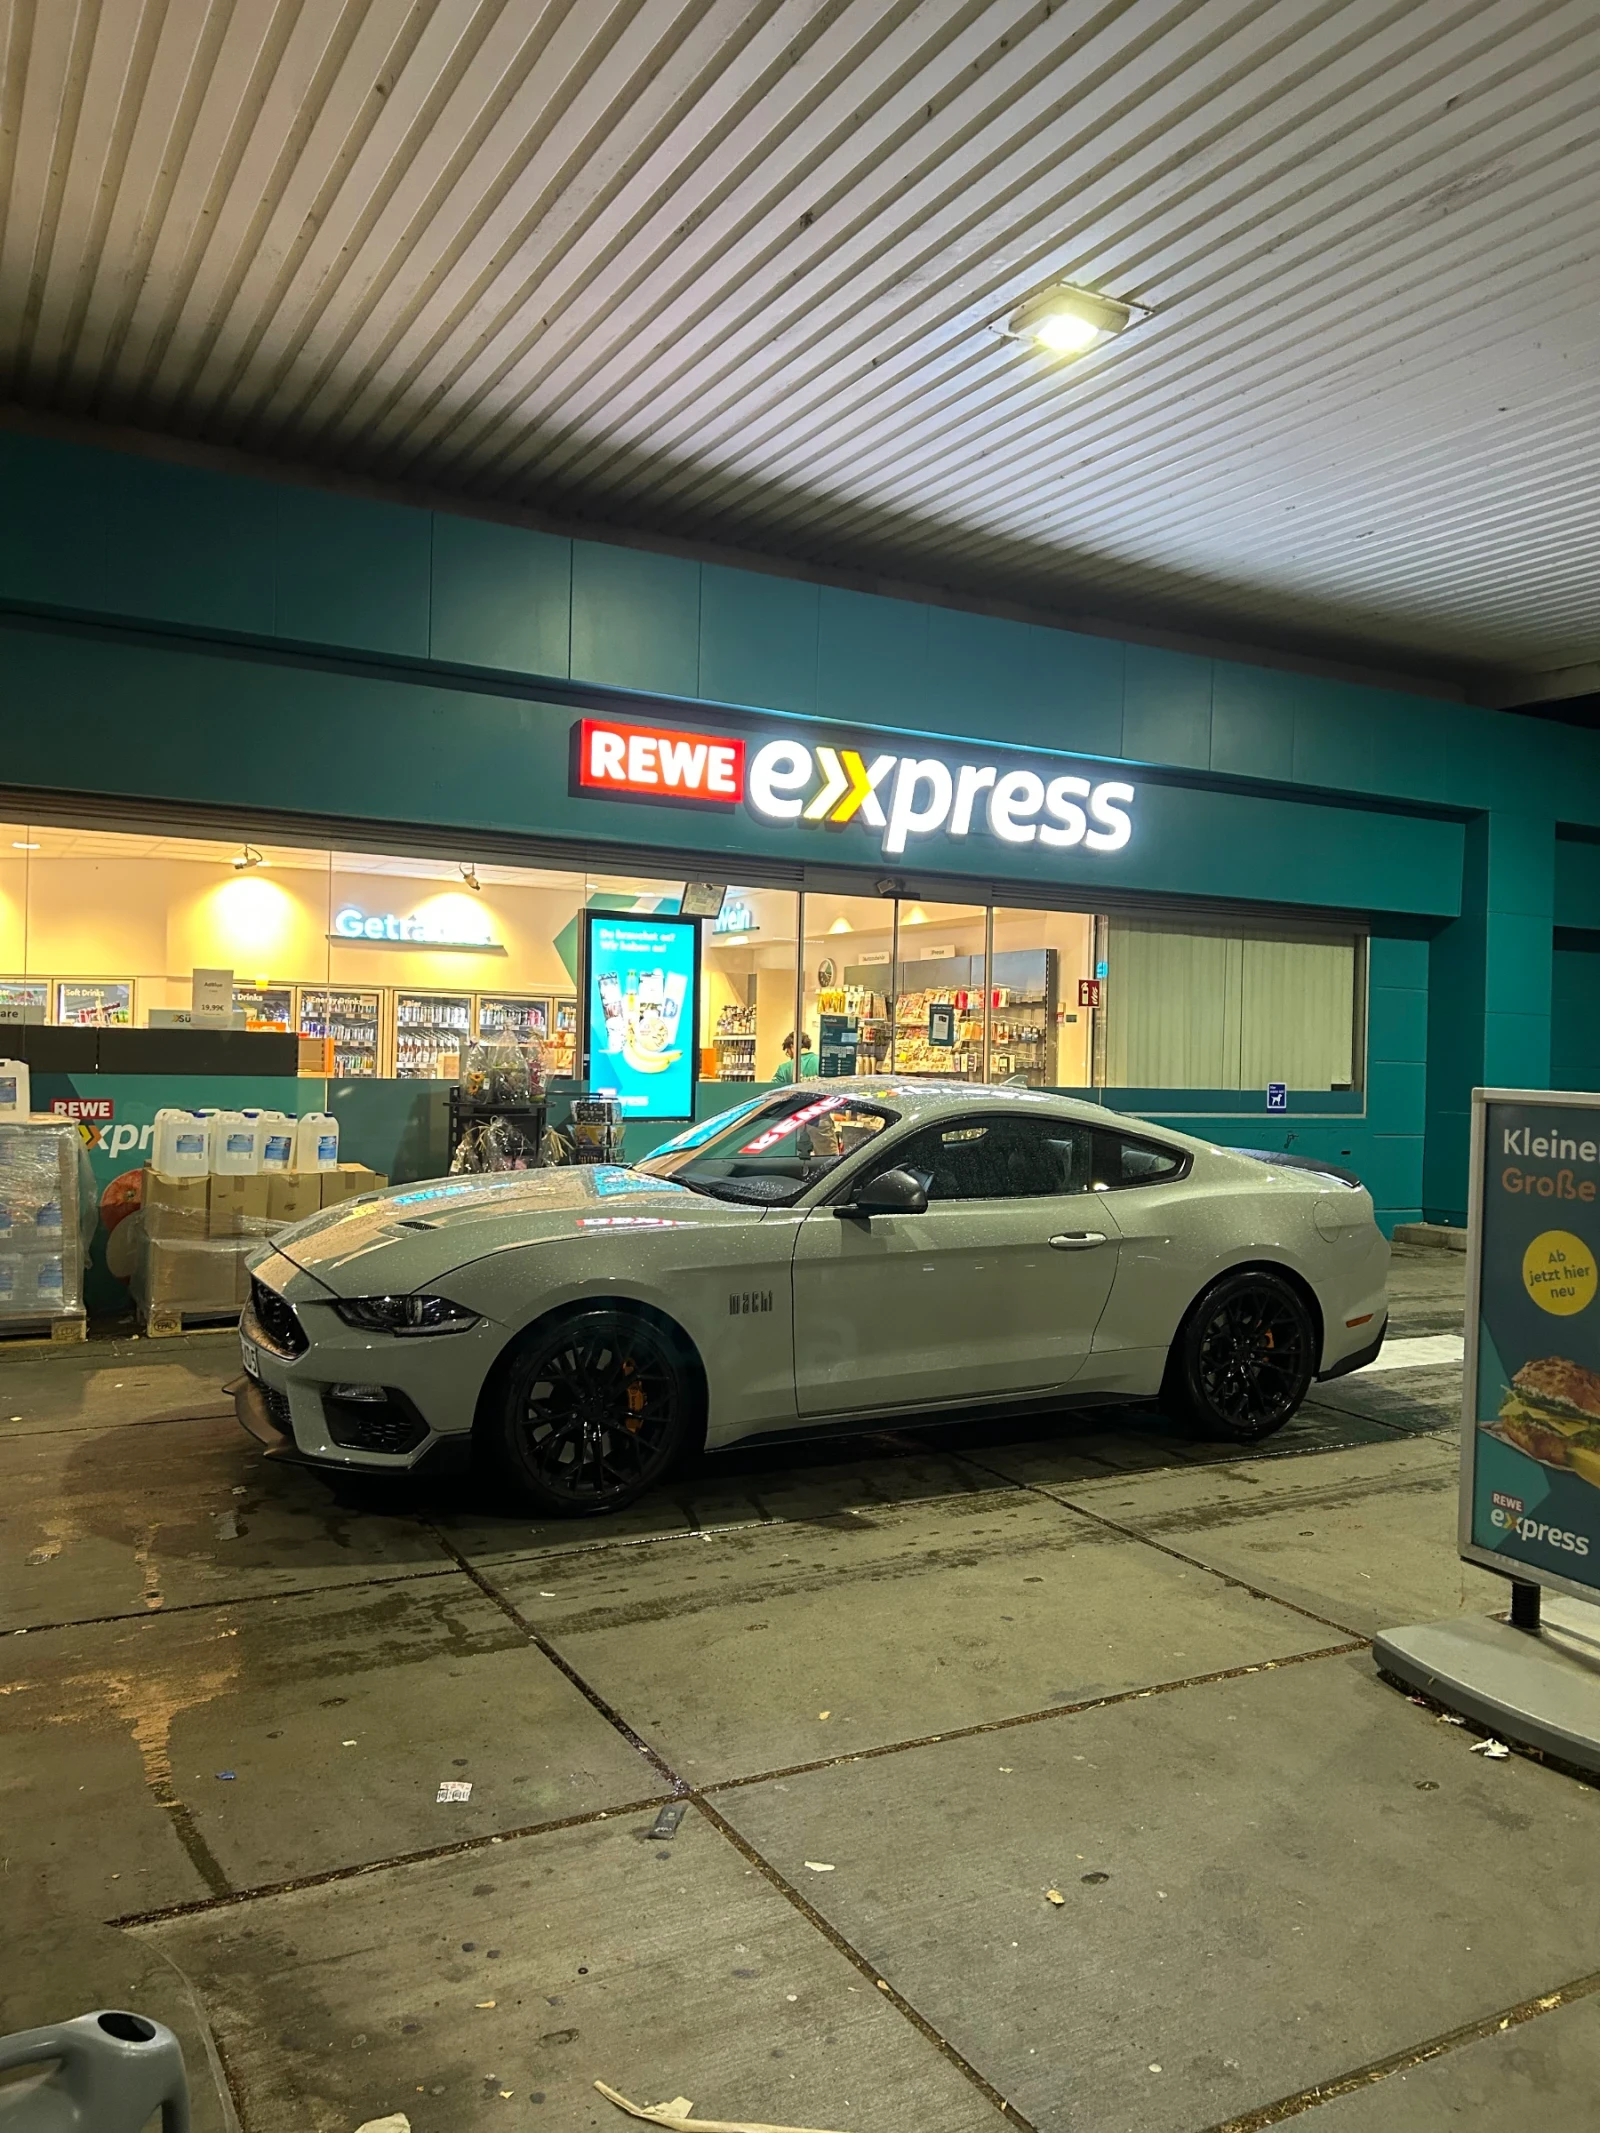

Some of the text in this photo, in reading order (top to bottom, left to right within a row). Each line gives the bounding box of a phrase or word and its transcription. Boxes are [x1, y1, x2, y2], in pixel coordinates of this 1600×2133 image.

[590, 730, 1135, 853] REWE express
[716, 902, 750, 931] Wein
[66, 988, 105, 997] Soft Drinks
[237, 993, 263, 1002] Drinks
[311, 996, 362, 1006] Energy Drinks
[201, 1004, 225, 1012] 19,99€
[53, 1101, 112, 1117] REWE
[1503, 1127, 1600, 1162] Kleine
[1501, 1167, 1596, 1202] Große
[1548, 1249, 1567, 1264] Ab
[1529, 1264, 1590, 1287] jetzt hier
[1550, 1286, 1576, 1299] neu
[1493, 1493, 1523, 1512] REWE
[1490, 1508, 1589, 1556] express
